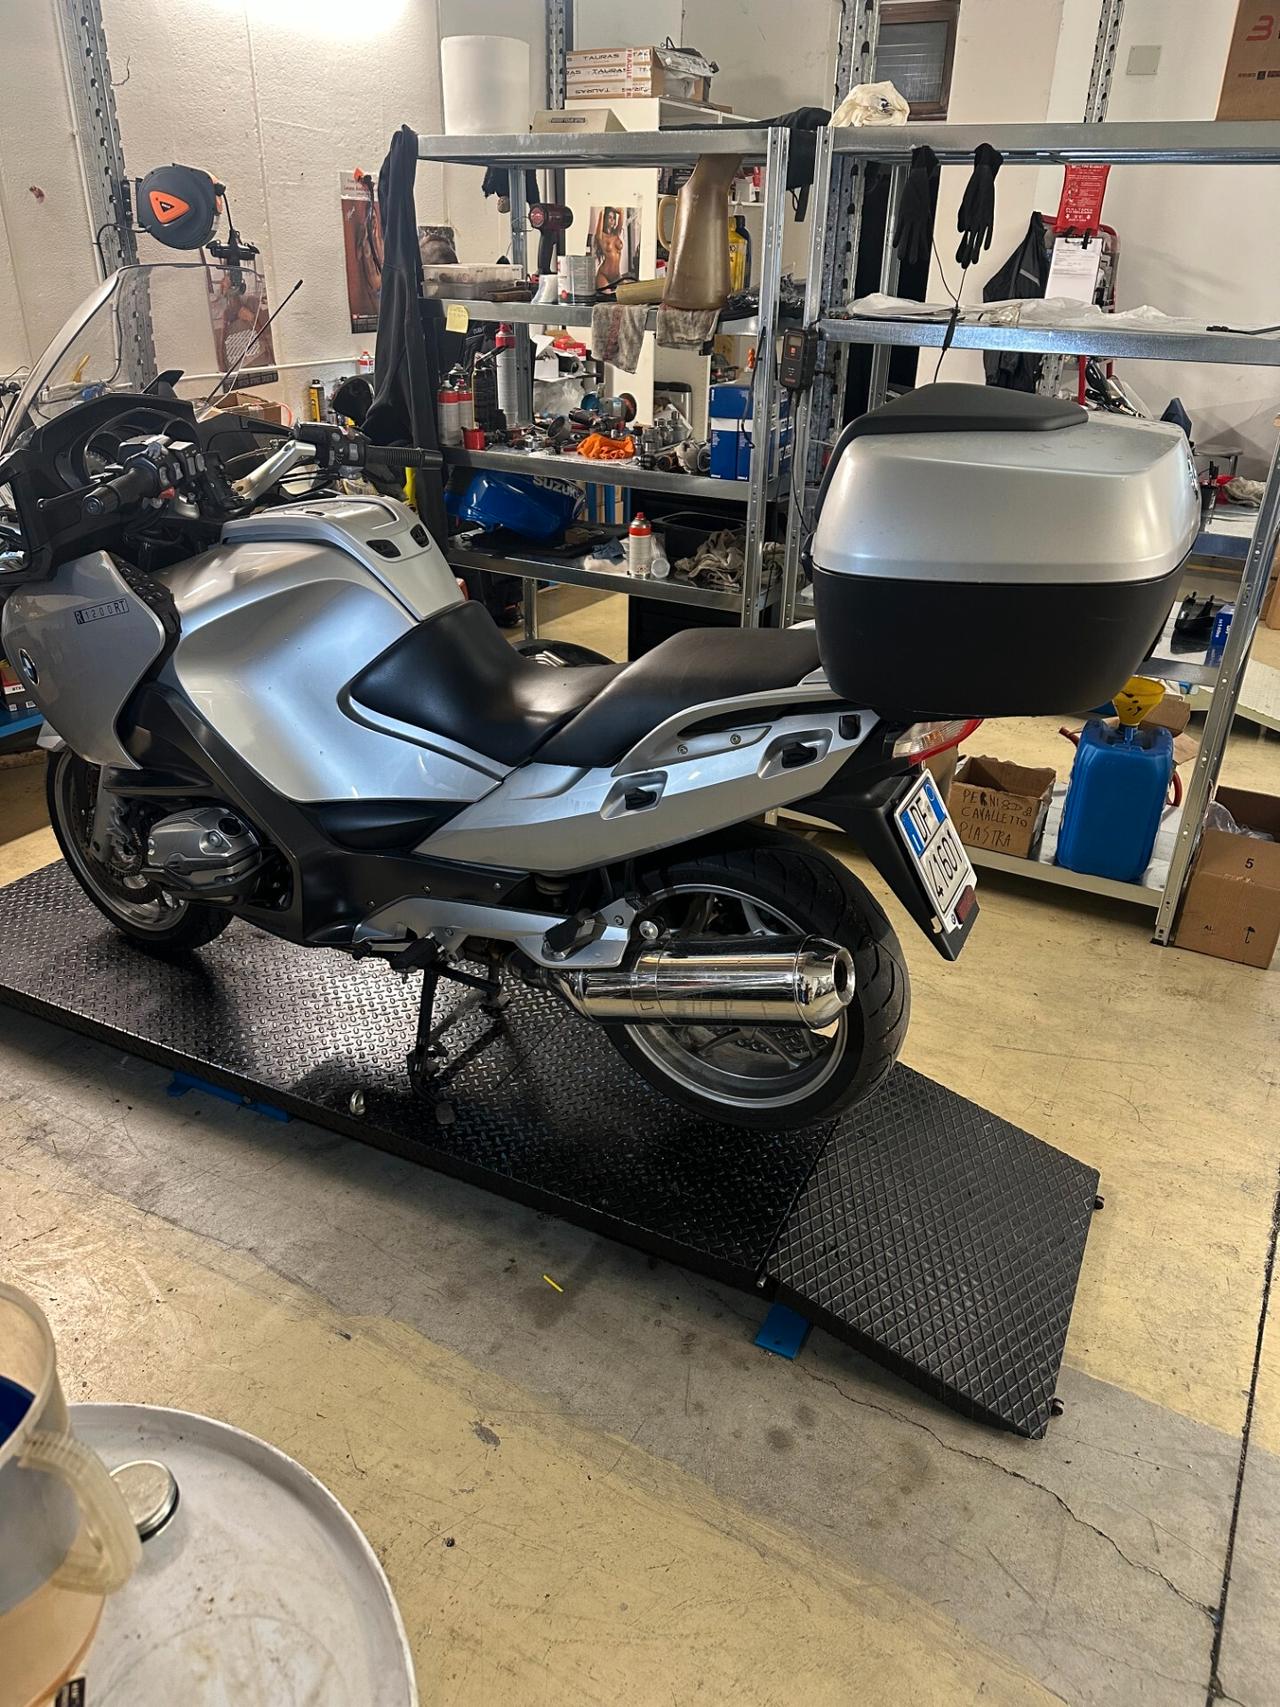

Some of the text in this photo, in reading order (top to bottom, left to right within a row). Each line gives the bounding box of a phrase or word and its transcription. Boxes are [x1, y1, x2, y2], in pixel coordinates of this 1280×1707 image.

[962, 789, 999, 807] PERNI
[909, 797, 931, 843] DF
[961, 806, 1028, 828] CAVALLETTO
[960, 821, 1011, 847] PIASTRA
[928, 830, 963, 898] 41601
[1245, 858, 1254, 869] 5
